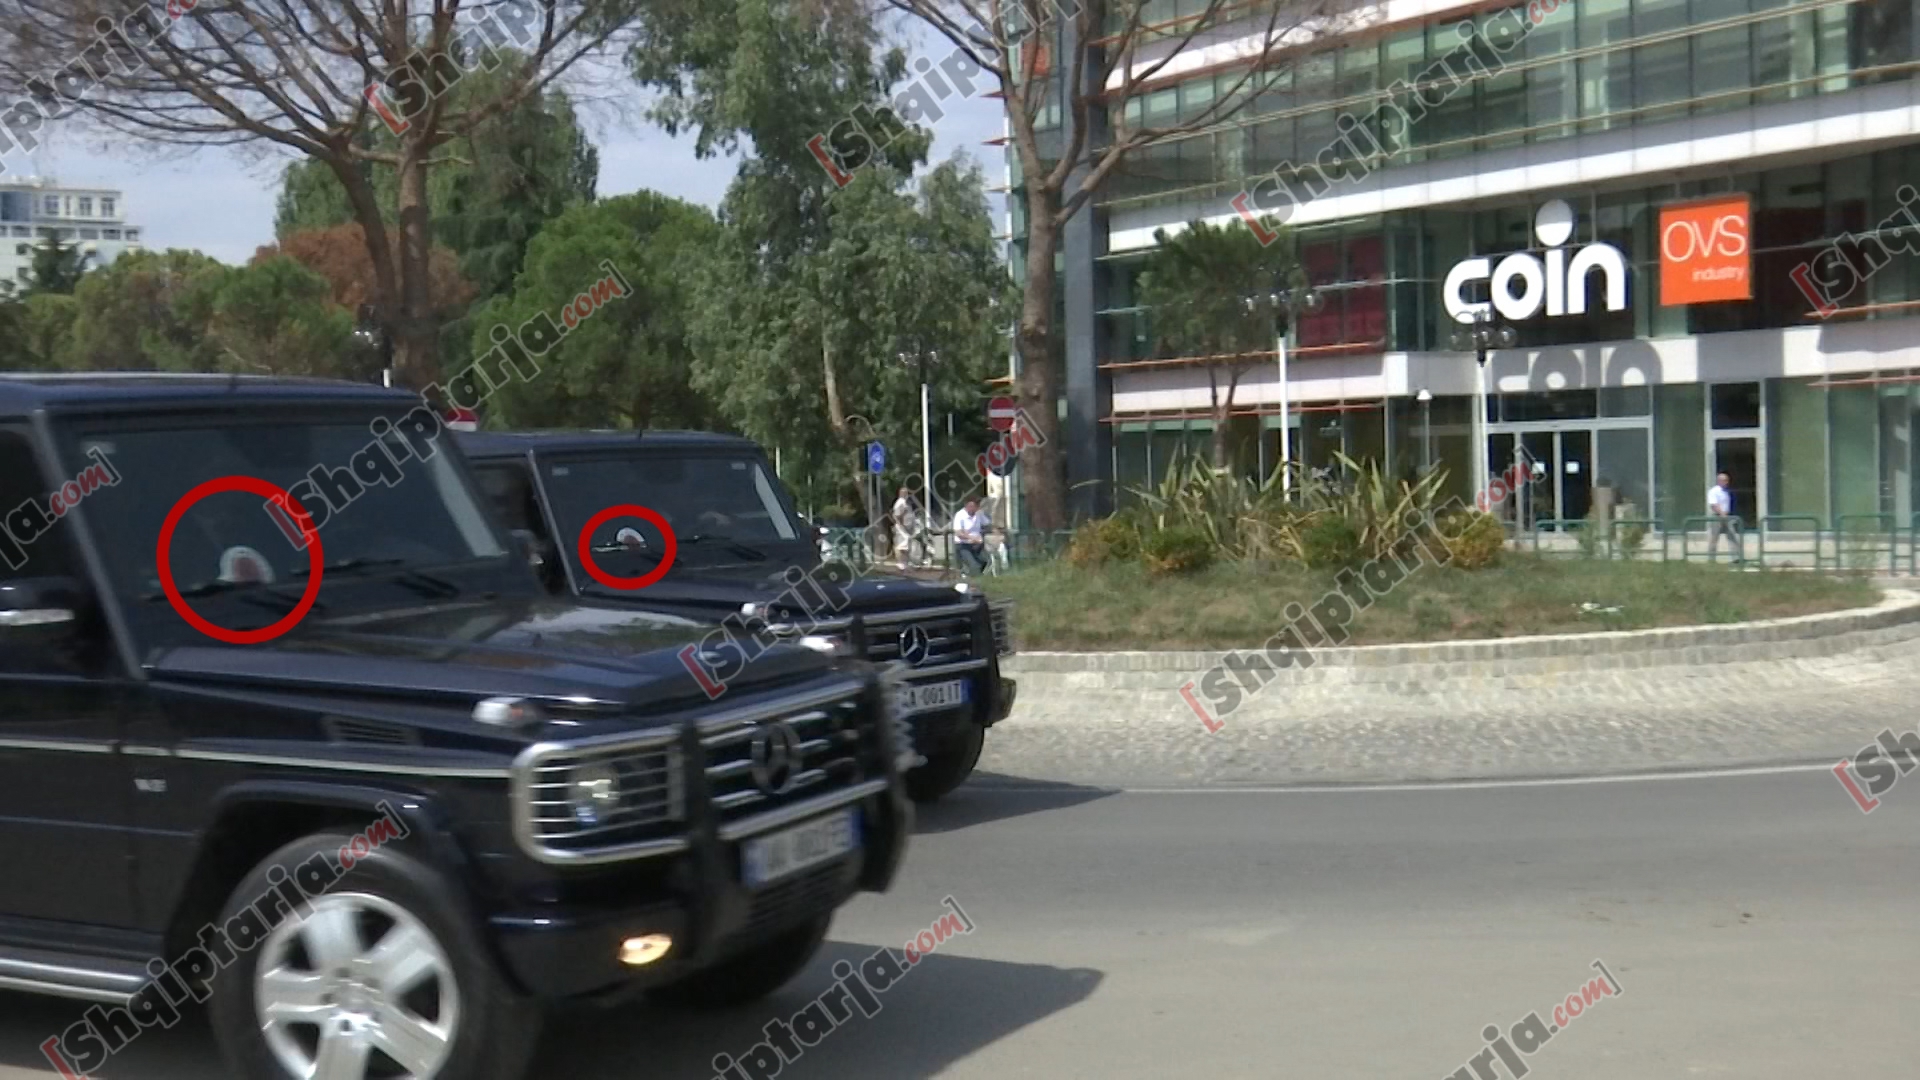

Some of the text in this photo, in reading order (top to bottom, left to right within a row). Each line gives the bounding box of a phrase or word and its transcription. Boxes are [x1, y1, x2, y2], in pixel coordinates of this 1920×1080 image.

[1444, 199, 1625, 323] coin
[1664, 215, 1746, 262] OVS
[1692, 266, 1744, 282] industry
